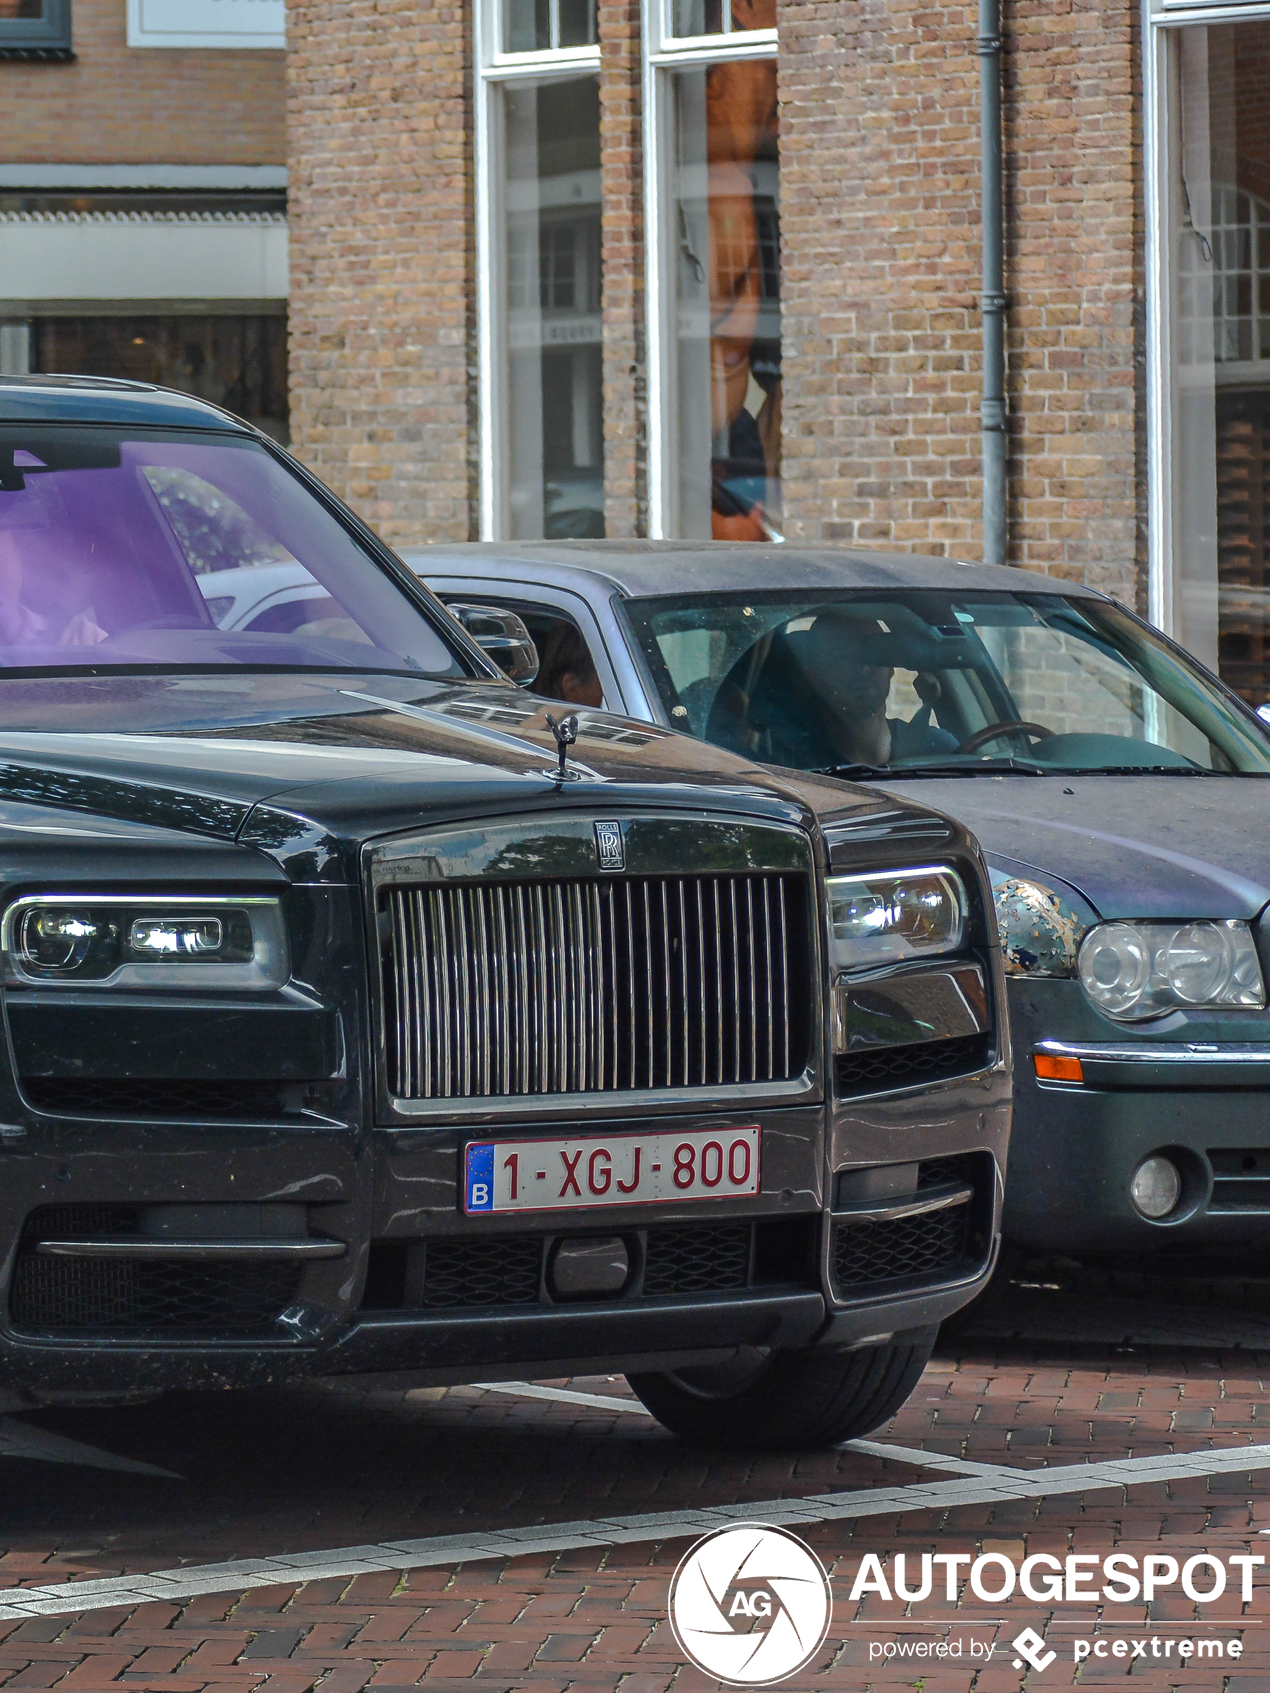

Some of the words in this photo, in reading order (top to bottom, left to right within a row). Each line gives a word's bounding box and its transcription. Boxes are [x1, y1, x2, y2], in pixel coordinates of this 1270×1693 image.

[601, 832, 619, 858] RR
[471, 1183, 489, 1206] B
[503, 1138, 751, 1201] 1-XGJ-800
